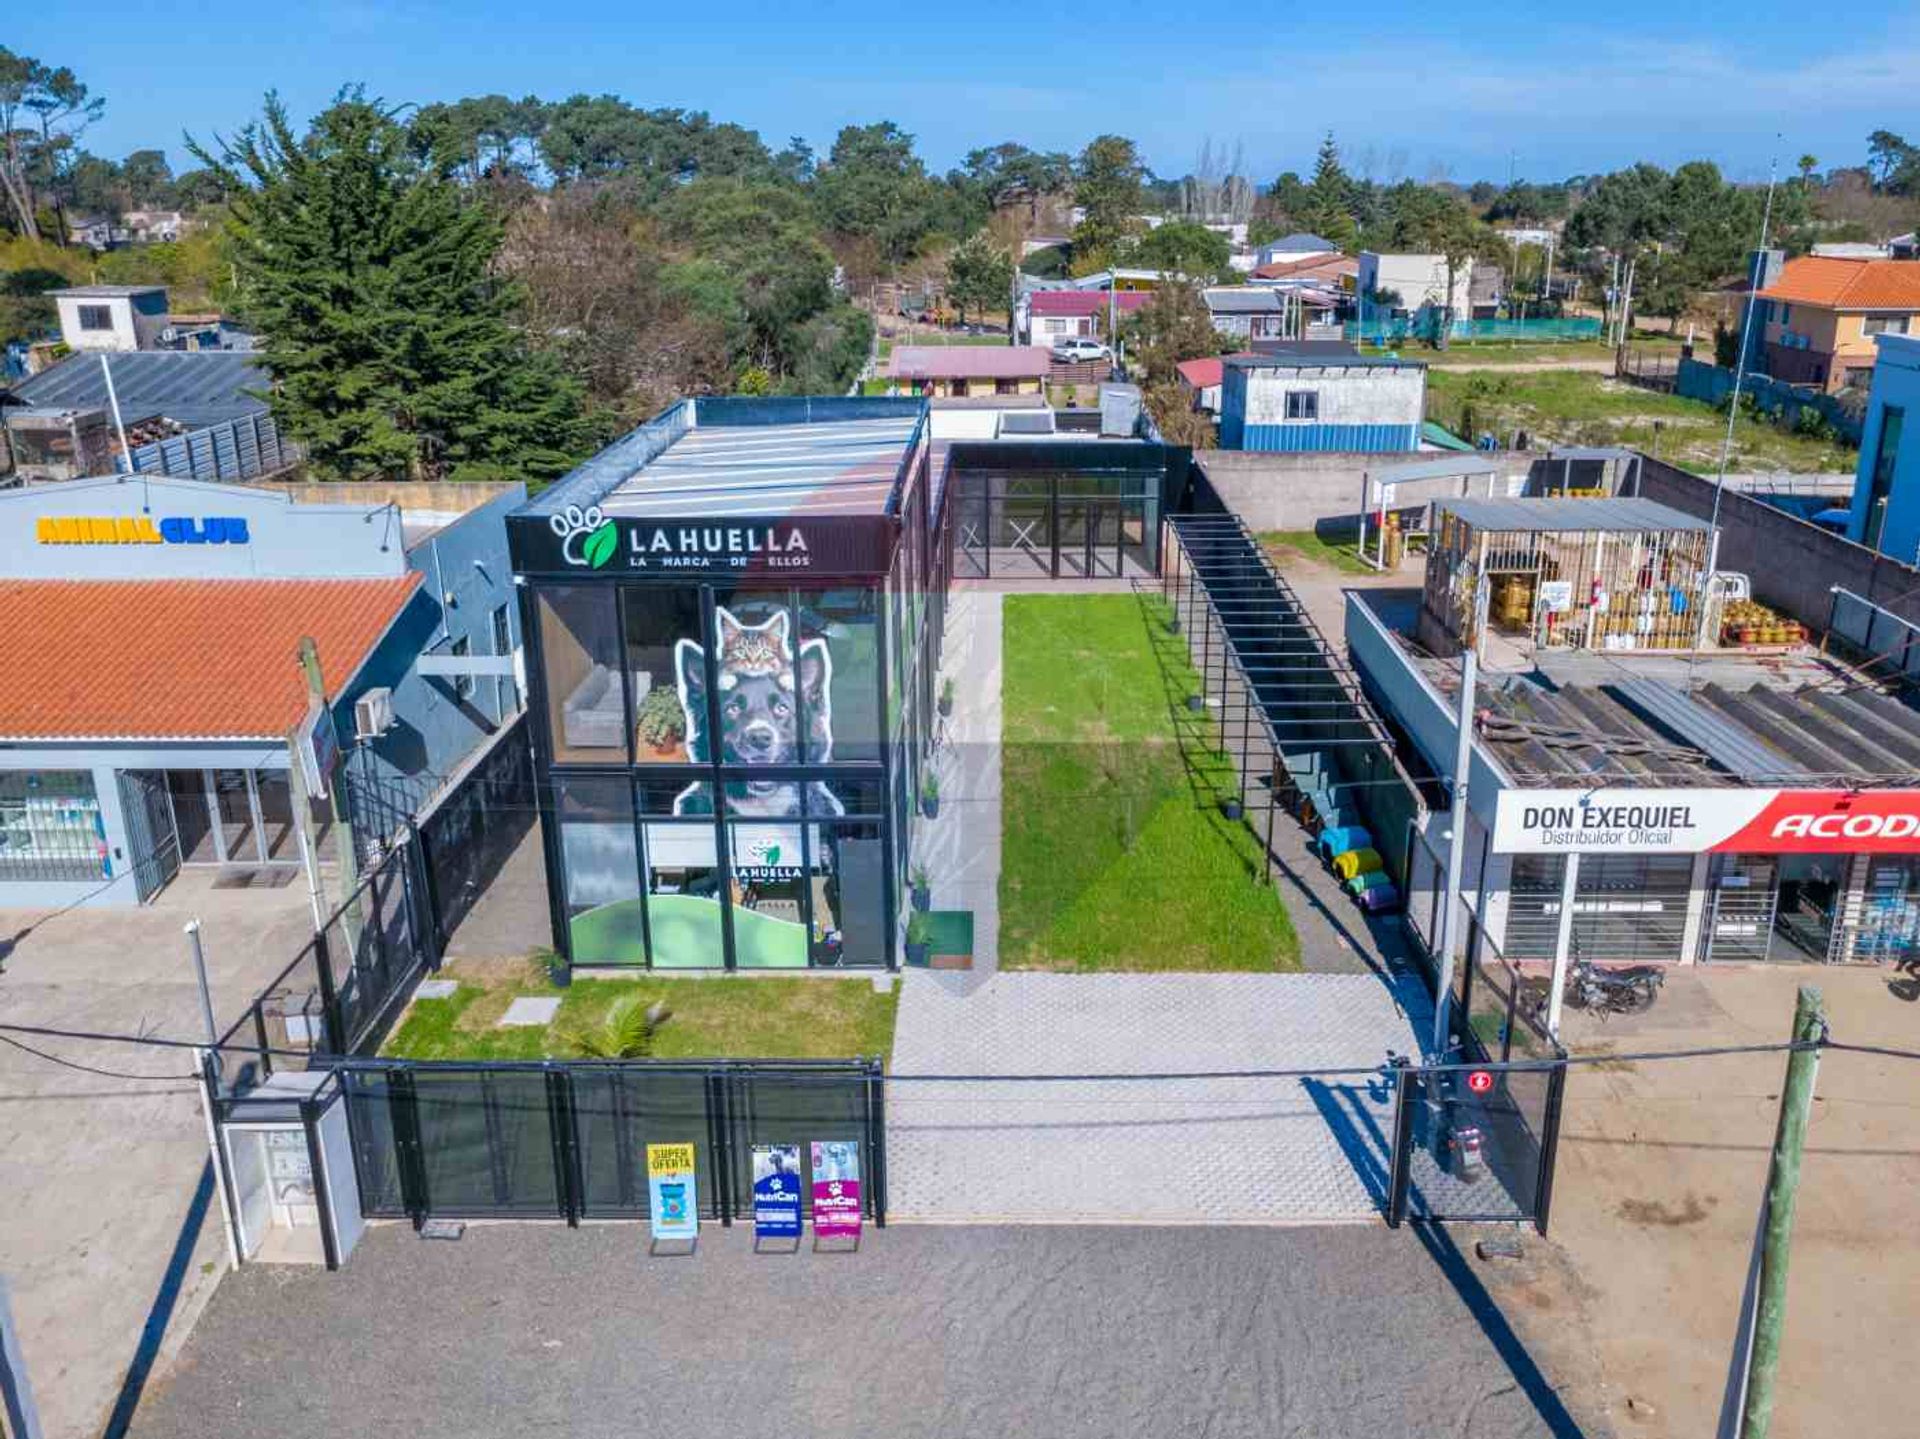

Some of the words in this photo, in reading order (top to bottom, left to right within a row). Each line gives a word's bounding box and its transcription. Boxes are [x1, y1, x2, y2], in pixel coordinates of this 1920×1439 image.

[630, 528, 672, 552] LA
[680, 528, 808, 552] HUELLA
[630, 557, 647, 567] LA
[663, 557, 710, 567] MARCA
[730, 557, 747, 567] DE
[768, 557, 810, 567] ELLOS
[1523, 807, 1574, 829] DON
[1581, 806, 1696, 829] EXEQUIEL
[1542, 829, 1623, 846] Distribuidor
[1628, 829, 1673, 845] Oficial
[750, 868, 802, 877] HUELLA
[653, 1148, 688, 1159] SUPER
[652, 1158, 691, 1170] OFERTA
[755, 1191, 798, 1202] NutriCan
